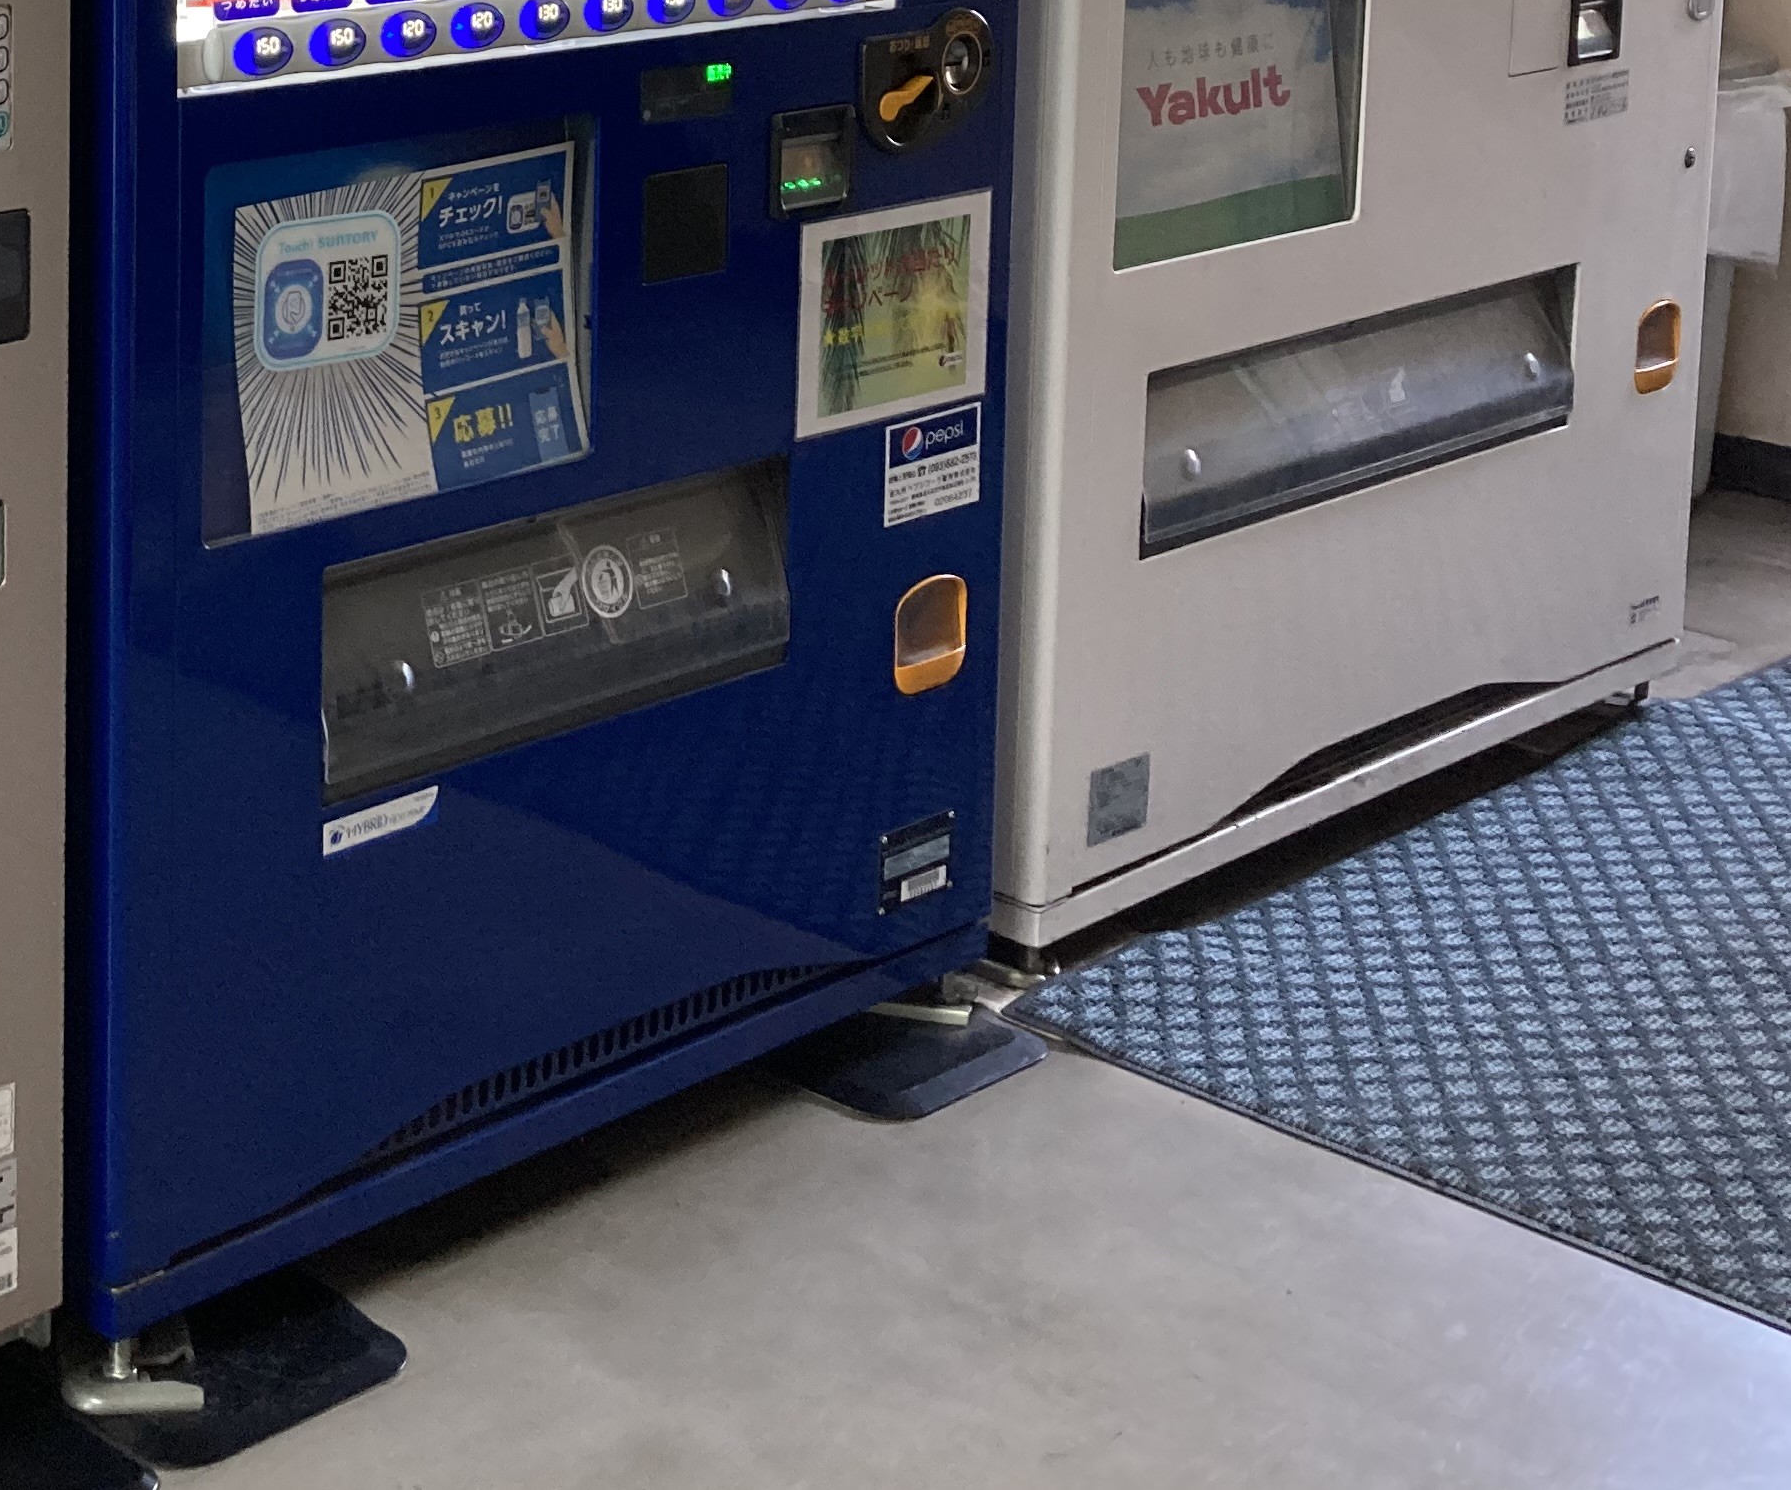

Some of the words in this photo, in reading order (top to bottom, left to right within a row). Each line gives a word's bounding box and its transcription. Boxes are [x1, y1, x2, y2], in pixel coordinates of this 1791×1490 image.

[257, 36, 281, 56] 150
[330, 27, 354, 46] 150
[402, 19, 424, 38] 120
[471, 10, 492, 29] 120
[538, 3, 558, 20] 130
[1147, 31, 1275, 71] 人も地球も健康に
[1136, 64, 1291, 128] Yakult
[439, 195, 503, 228] チェック!
[318, 230, 378, 252] SUNTORY
[440, 310, 507, 346] スキャン!
[925, 419, 964, 450] pepsi
